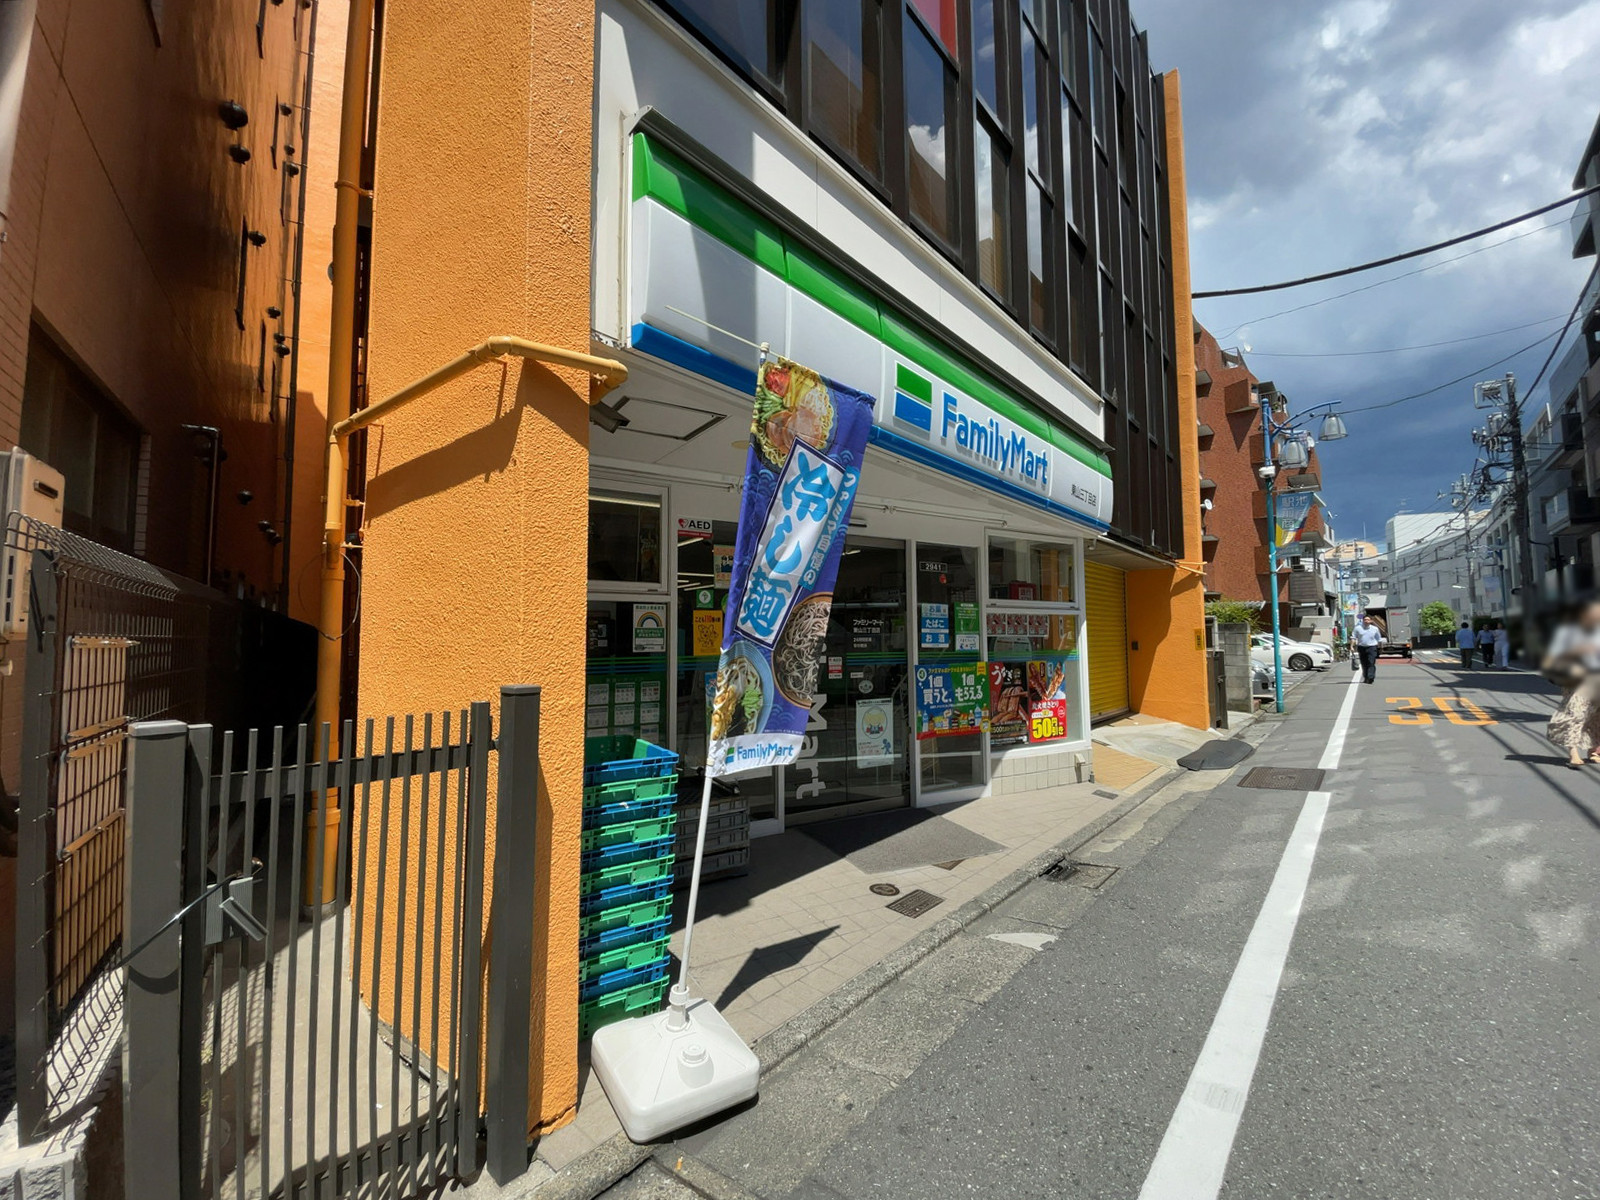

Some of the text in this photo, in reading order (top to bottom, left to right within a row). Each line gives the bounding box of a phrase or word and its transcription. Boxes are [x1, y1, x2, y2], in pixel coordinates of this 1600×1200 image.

[942, 391, 1049, 485] FamilyMart
[688, 519, 711, 531] AED
[740, 452, 836, 638] 冷し麺
[925, 618, 946, 629] たばこ
[928, 674, 943, 689] 1個
[961, 672, 975, 687] 1個
[922, 687, 952, 706] 買うと、
[955, 685, 984, 702] もらえる
[1385, 697, 1500, 726] 30
[736, 742, 795, 760] FamilyMart
